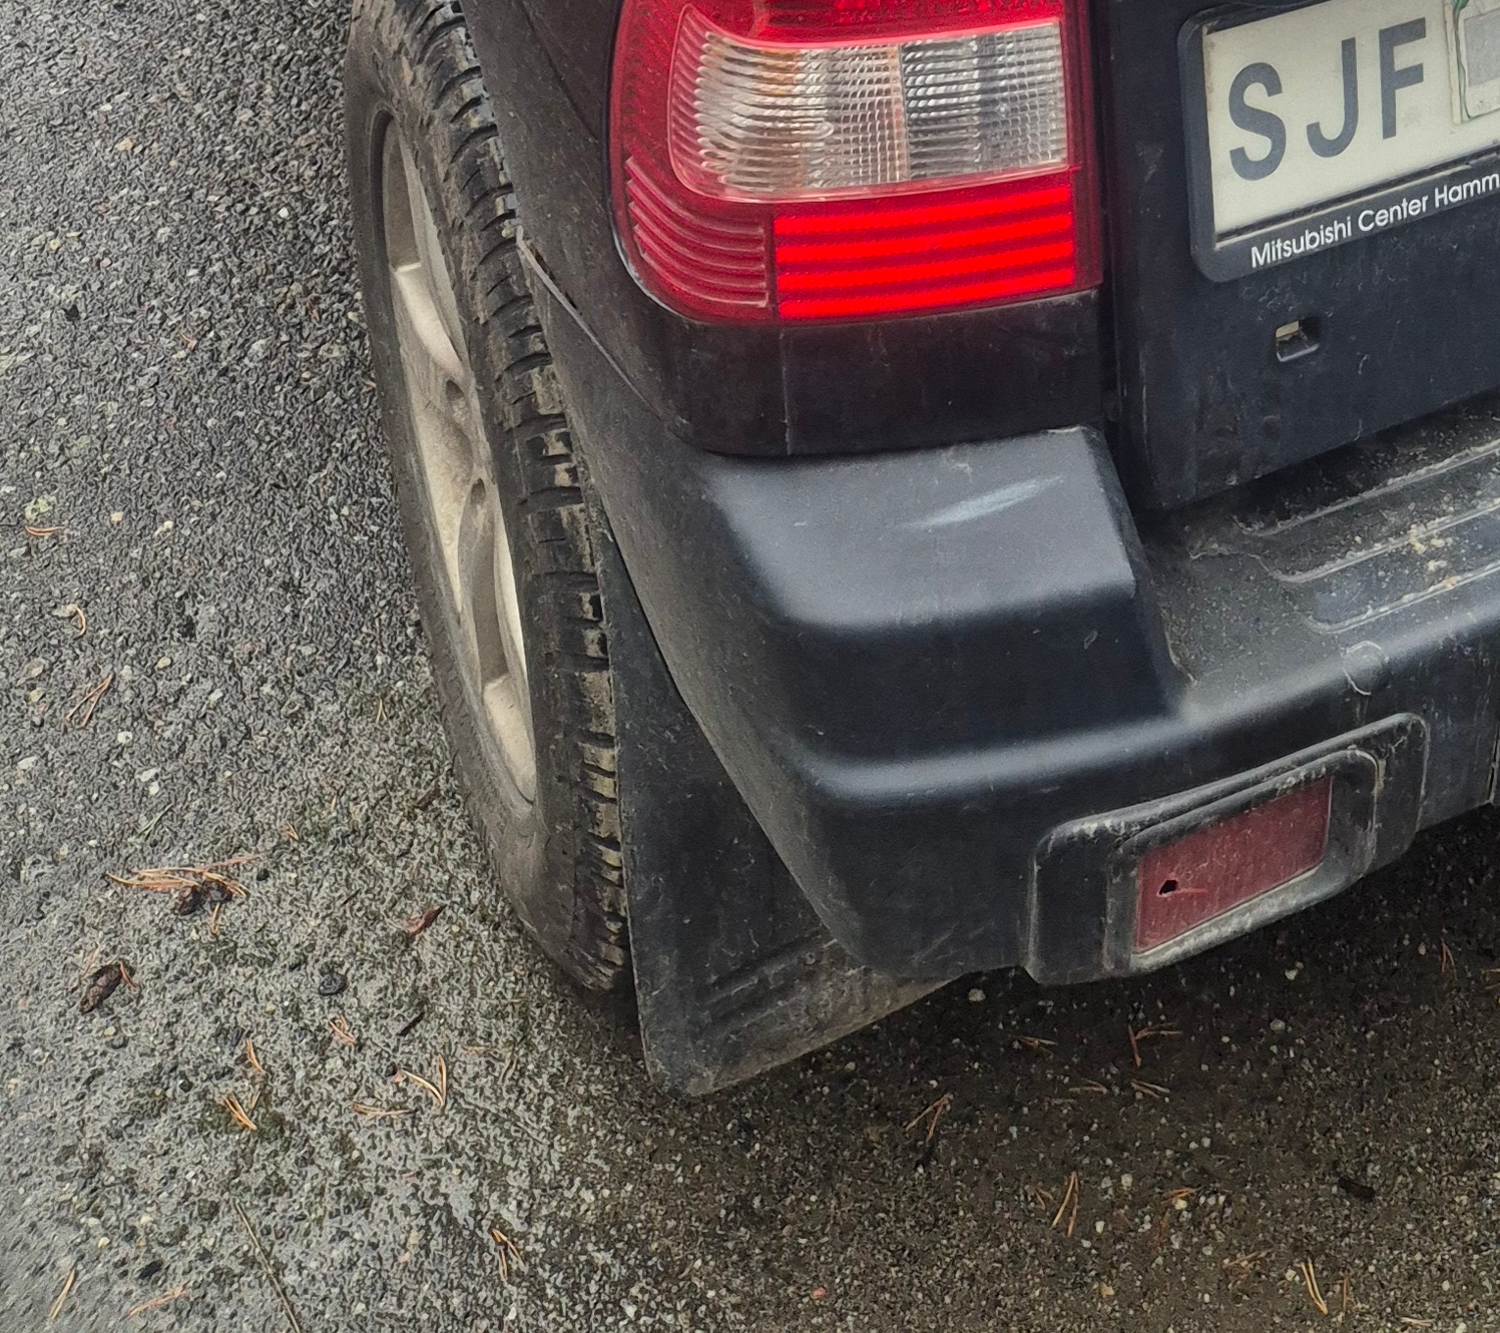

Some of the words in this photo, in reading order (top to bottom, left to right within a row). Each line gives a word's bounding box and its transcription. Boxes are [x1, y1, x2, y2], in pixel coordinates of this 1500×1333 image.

[1228, 17, 1427, 182] SJF
[1250, 216, 1352, 268] Mitsubishi
[1358, 194, 1428, 232] Center
